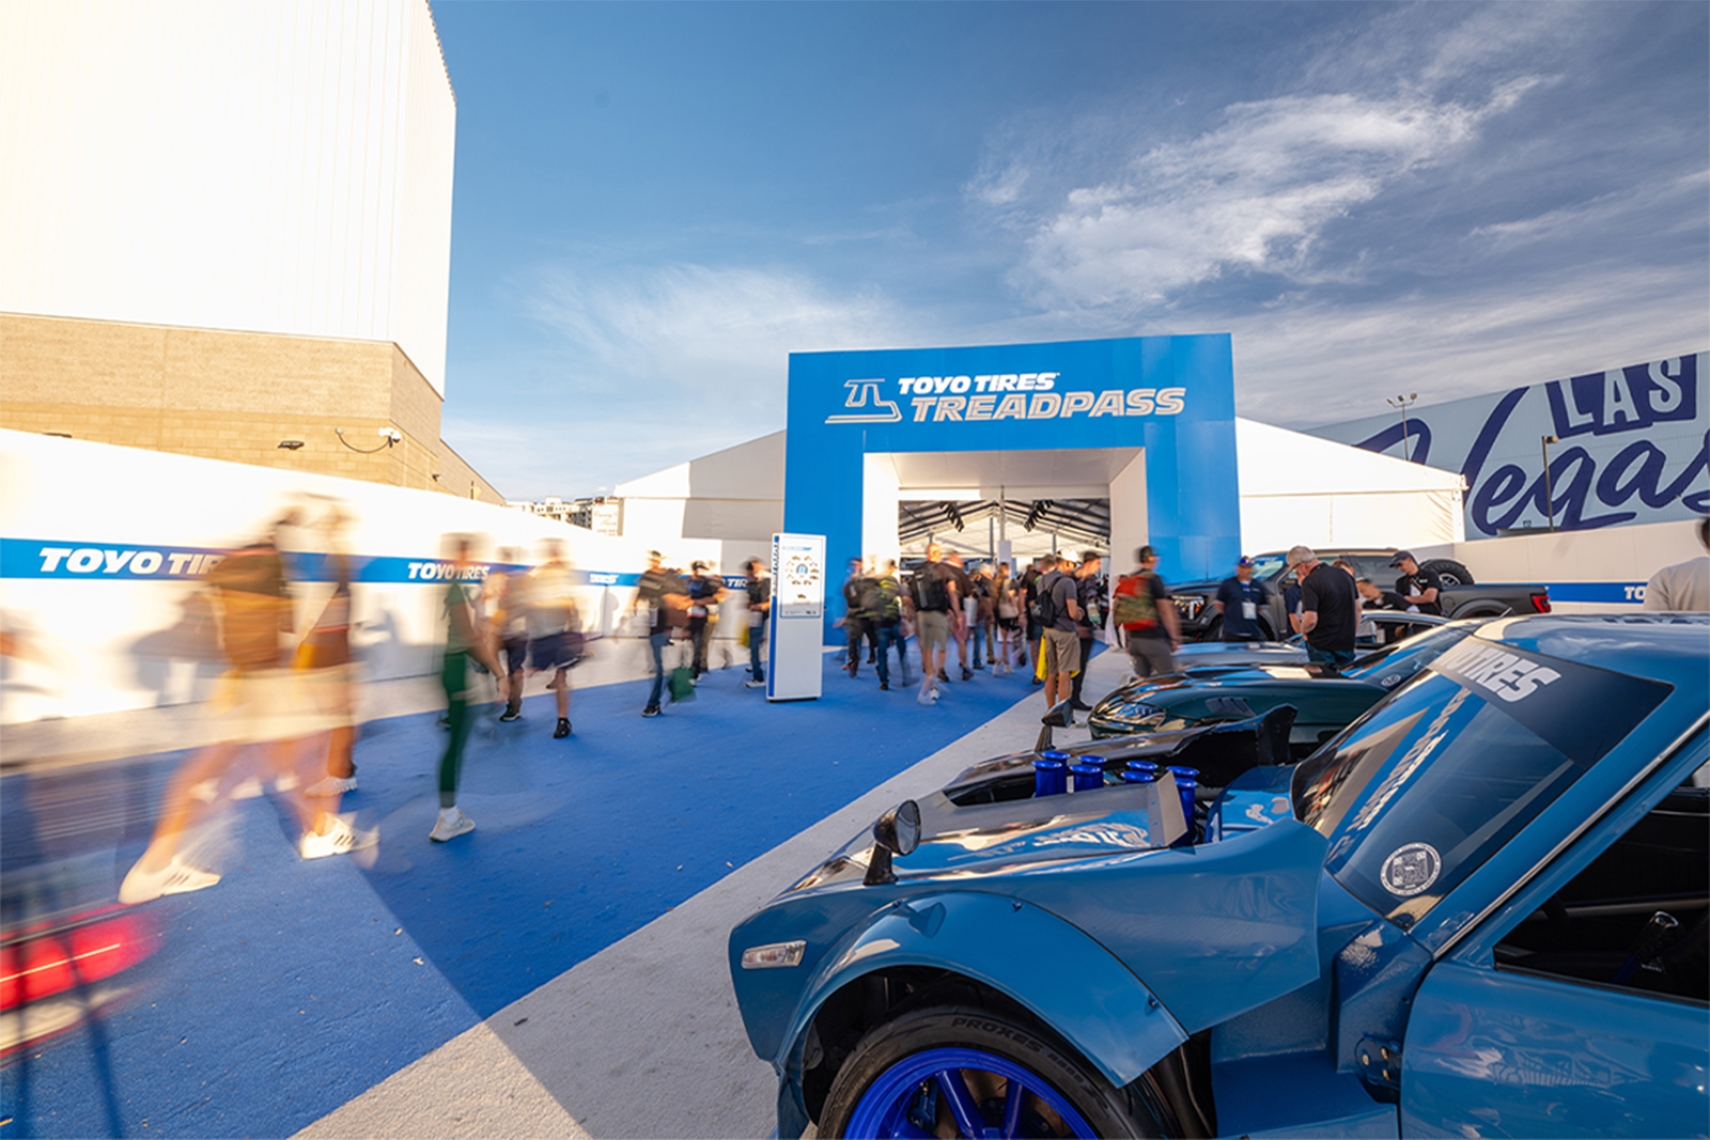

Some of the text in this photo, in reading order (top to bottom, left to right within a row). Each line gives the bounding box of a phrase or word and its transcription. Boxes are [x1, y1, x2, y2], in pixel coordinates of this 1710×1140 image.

[898, 372, 1059, 395] TOYO TIRES
[1559, 356, 1683, 427] LAS
[911, 387, 1186, 422] TREADPASS
[39, 547, 227, 575] TOYO TIR
[728, 578, 748, 587] TIR
[1624, 586, 1647, 600] TO
[1457, 647, 1561, 702] TIRES
[952, 1017, 1043, 1052] PROXES
